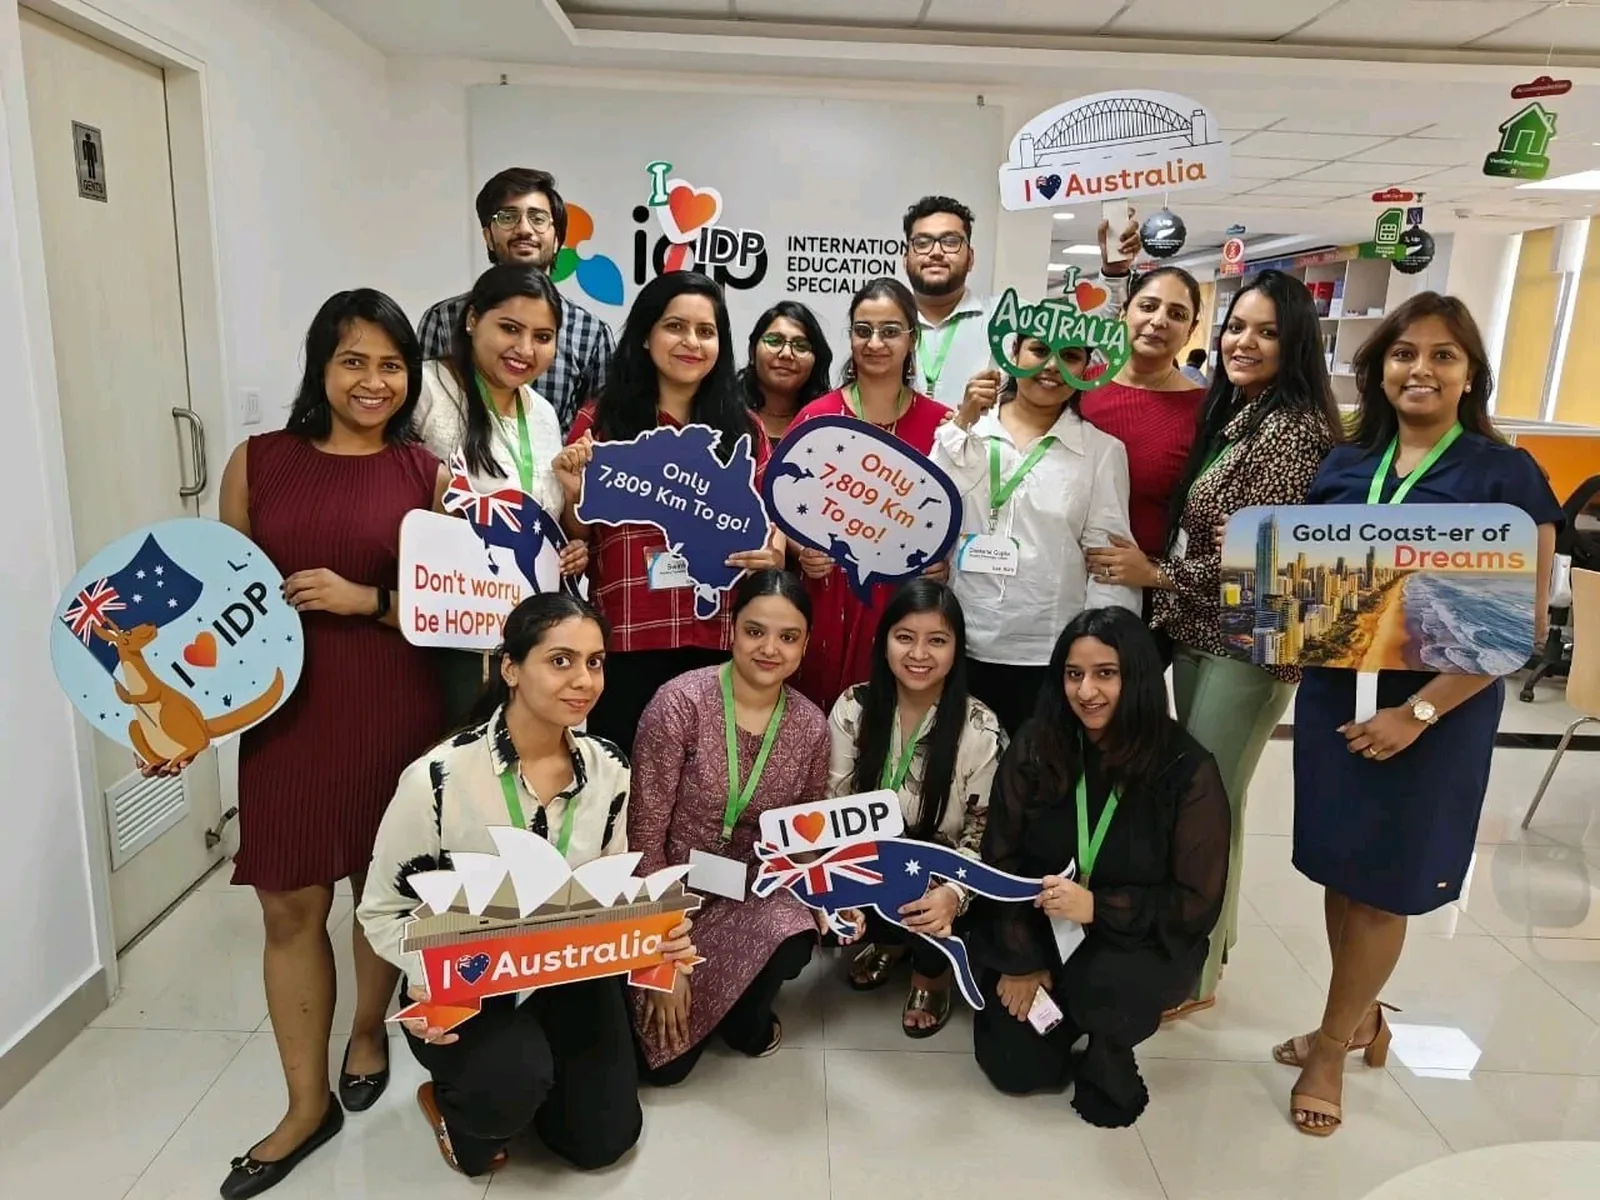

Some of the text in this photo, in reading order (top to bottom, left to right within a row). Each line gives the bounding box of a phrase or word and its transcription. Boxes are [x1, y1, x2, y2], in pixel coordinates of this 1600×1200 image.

[83, 179, 103, 194] GENTS
[647, 160, 674, 207] I
[1024, 158, 1206, 202] I Australia
[697, 227, 765, 267] IDP
[787, 236, 909, 256] INTERNATION
[787, 256, 896, 275] EDUCATION
[786, 276, 866, 294] SPECIALI
[1063, 266, 1080, 294] I
[663, 463, 710, 496] Only
[819, 462, 915, 528] 7,809 Km
[861, 453, 915, 497] Only
[598, 465, 751, 533] 7,809 Km To go!
[821, 496, 888, 544] To go!
[1292, 523, 1511, 542] Gold Coast-er of
[1394, 544, 1526, 569] Dreams
[415, 564, 521, 607] Don't worry
[171, 581, 269, 688] I IDP
[415, 606, 507, 637] be HOPPY
[778, 801, 889, 847] I IDP
[442, 928, 663, 989] I Australia
